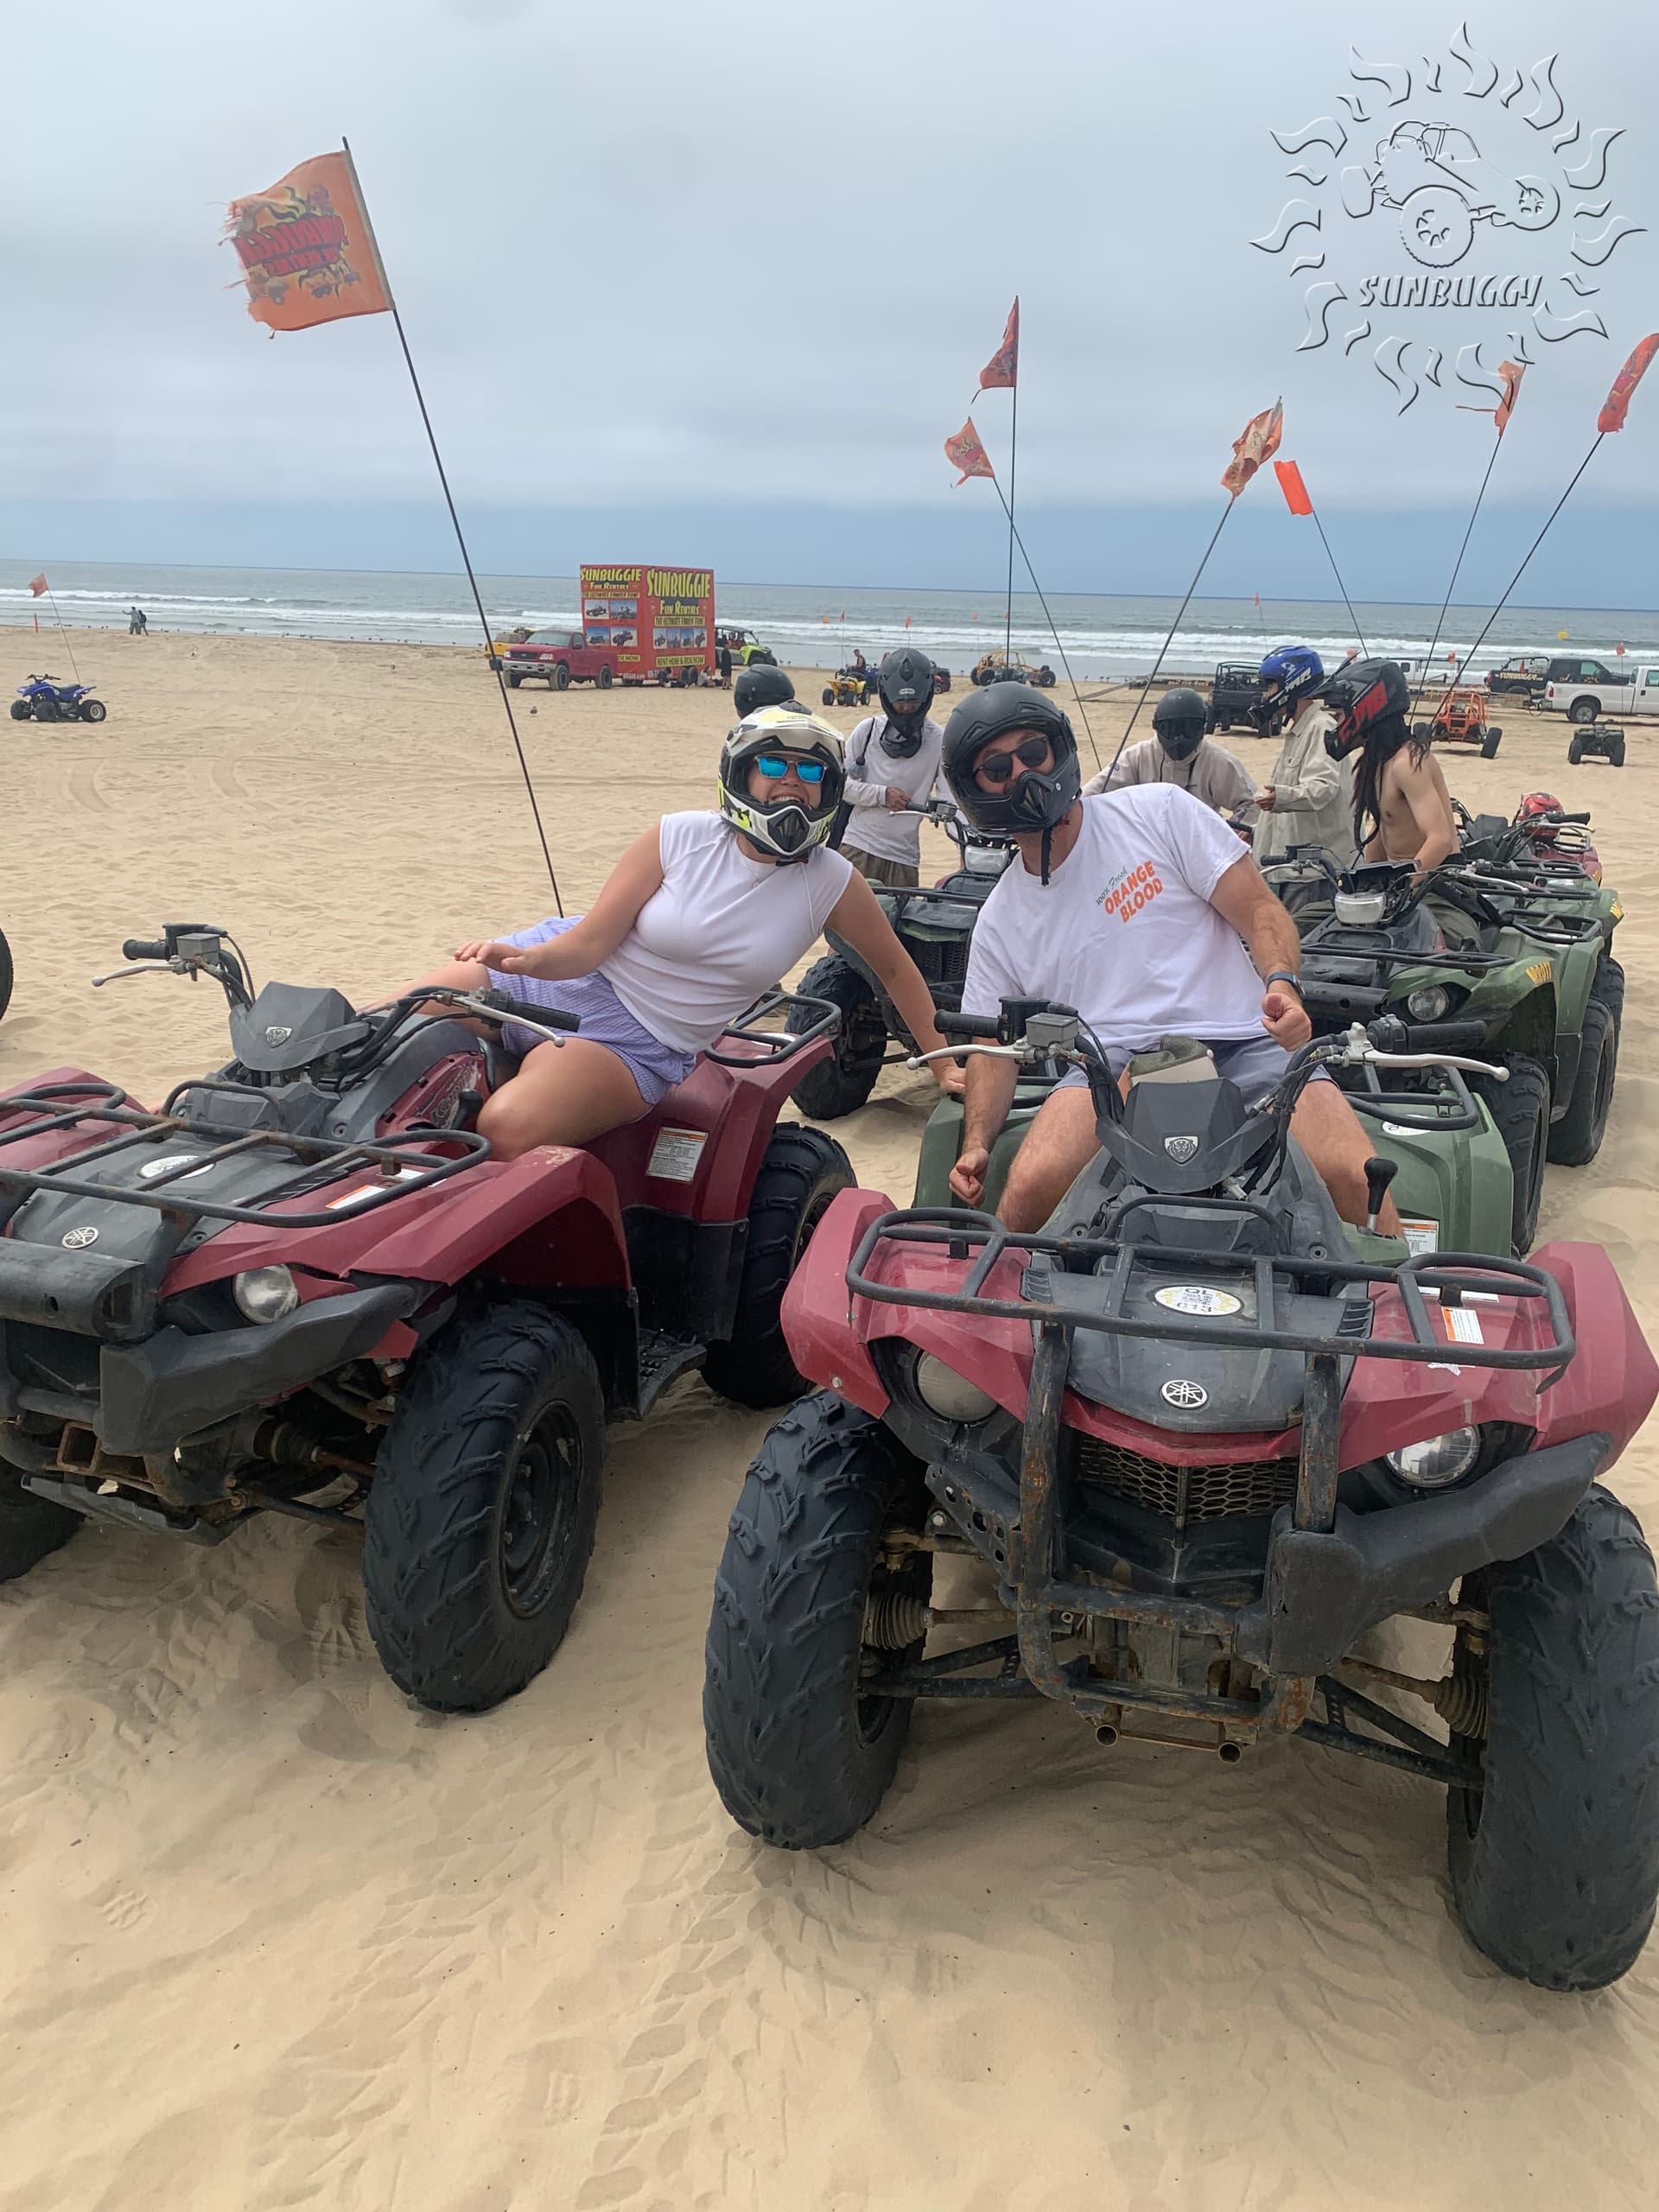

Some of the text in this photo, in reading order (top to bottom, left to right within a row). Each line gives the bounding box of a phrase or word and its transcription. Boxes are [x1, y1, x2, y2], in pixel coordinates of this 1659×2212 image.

[581, 568, 641, 581] SUNBUGGIE
[647, 569, 710, 598] SUNBUGGIE
[1104, 859, 1155, 914] ORANGE
[1120, 877, 1163, 924] BLOOD
